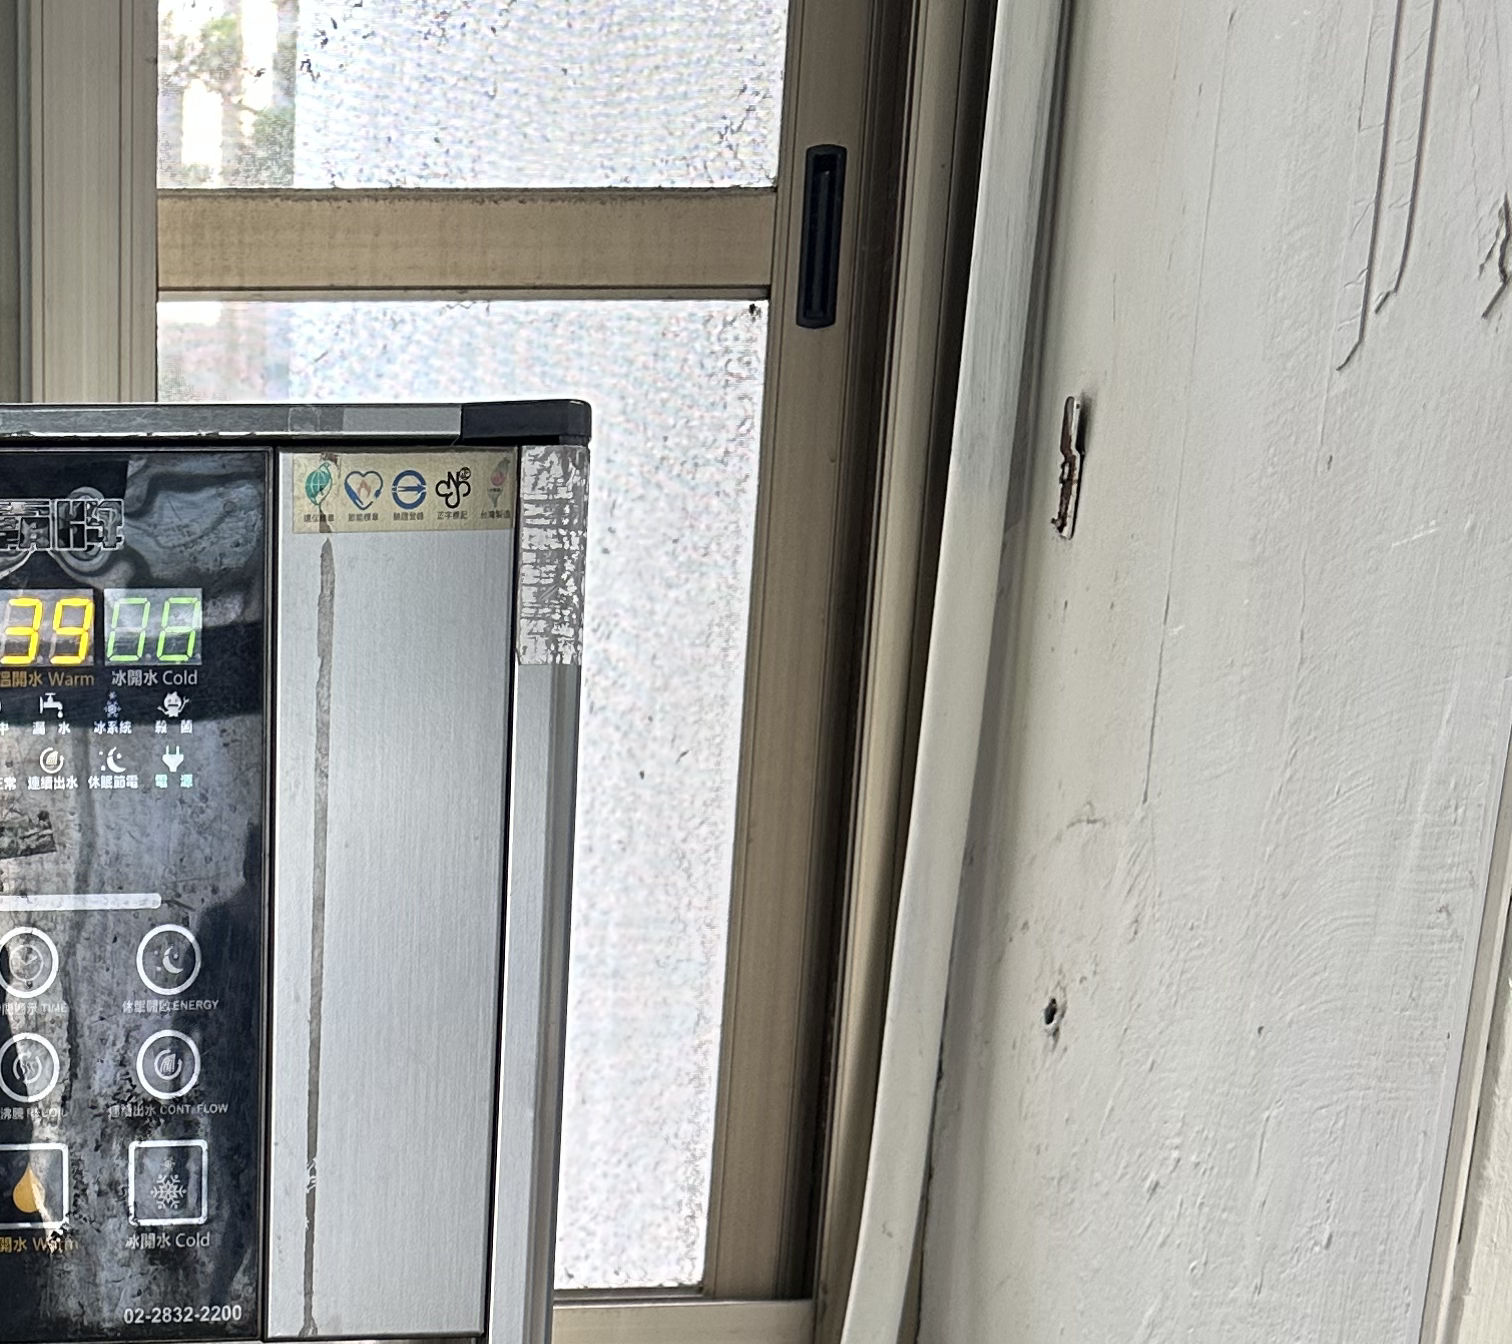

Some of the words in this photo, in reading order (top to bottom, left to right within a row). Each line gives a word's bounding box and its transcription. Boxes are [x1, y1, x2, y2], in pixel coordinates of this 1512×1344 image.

[0, 597, 95, 665] 39
[107, 597, 203, 662] 08
[48, 672, 94, 686] Warm
[112, 670, 158, 686] 冰開水
[162, 670, 198, 685] Cold
[93, 720, 132, 735] 冰系統
[27, 775, 79, 790] 連續出水
[172, 1000, 219, 1011] ENERGY
[196, 1103, 229, 1114] FLOW
[125, 1234, 171, 1250] 冰開水
[175, 1233, 210, 1248] Cold
[124, 1305, 243, 1325] 02-2832-2200
